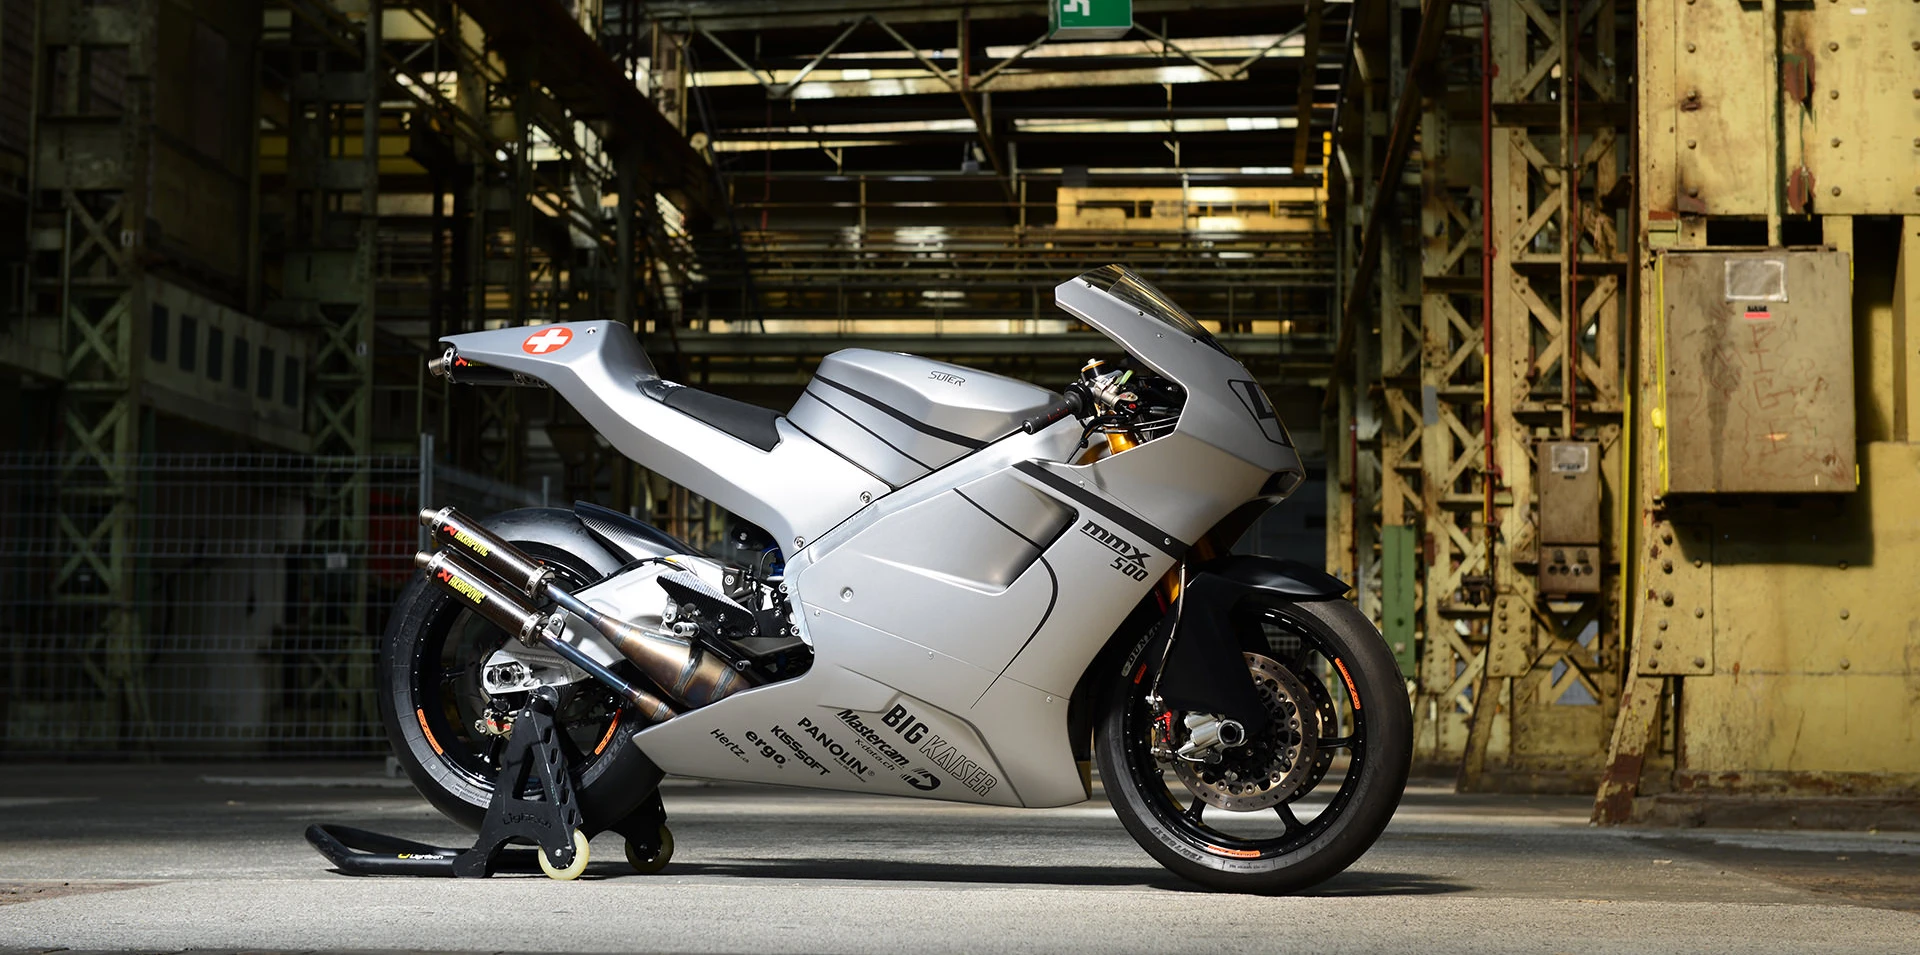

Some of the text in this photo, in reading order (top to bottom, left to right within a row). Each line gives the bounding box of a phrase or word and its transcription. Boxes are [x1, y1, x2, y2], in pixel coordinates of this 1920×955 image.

[928, 370, 966, 387] SUTER
[1109, 556, 1149, 582] 500
[836, 708, 910, 767] Mastercam
[881, 703, 929, 745] BIG
[918, 734, 998, 798] KAISER
